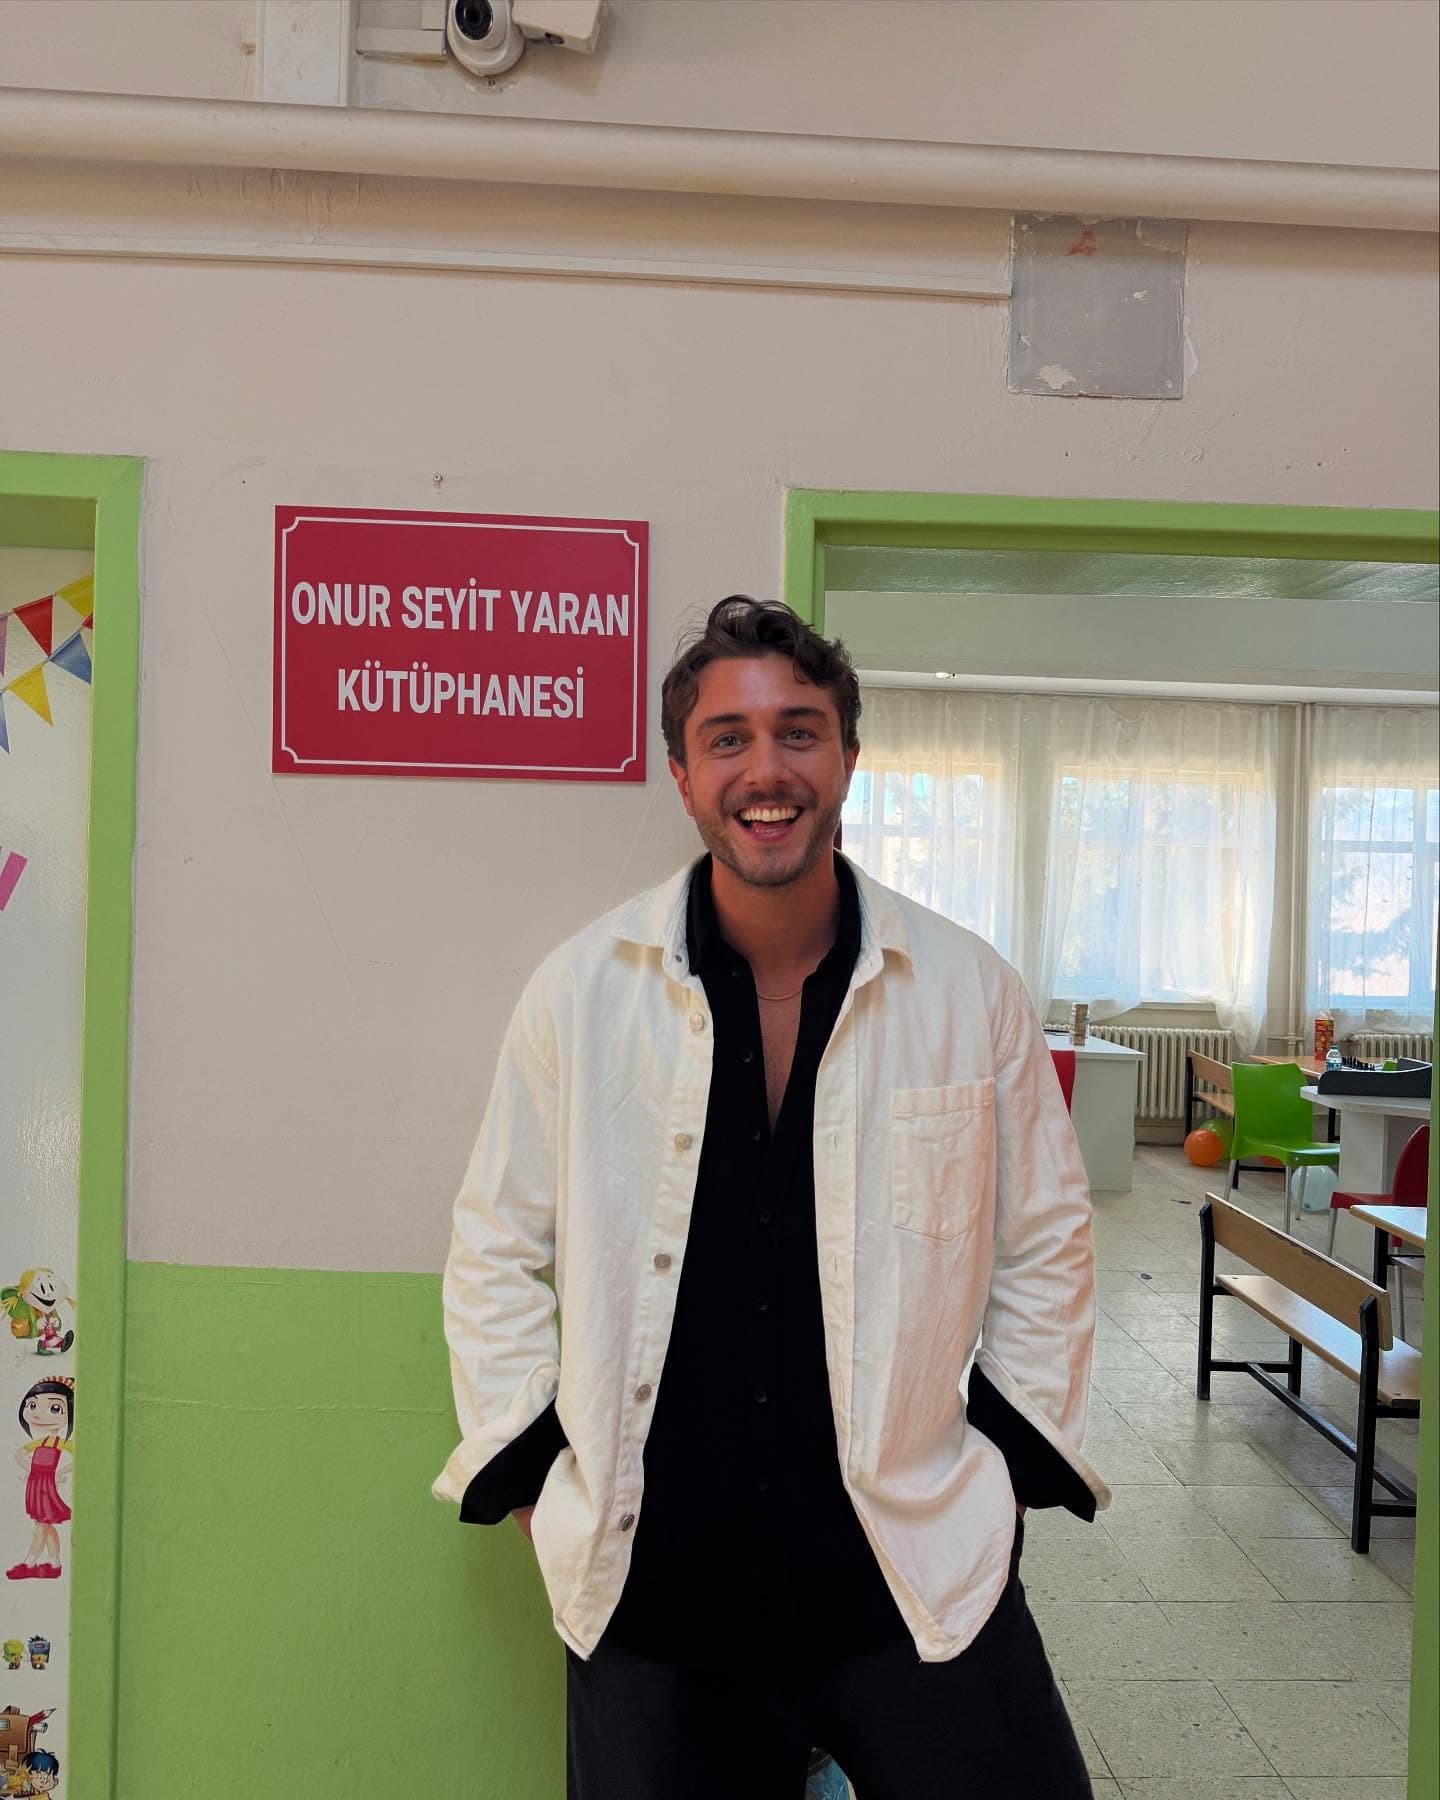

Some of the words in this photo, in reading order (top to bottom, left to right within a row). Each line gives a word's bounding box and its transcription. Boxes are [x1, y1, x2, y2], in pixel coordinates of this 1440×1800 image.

[291, 581, 391, 628] ONUR
[401, 577, 502, 632] SEYİT
[509, 590, 630, 637] YARAN
[337, 659, 585, 719] KÜTÜPHANESİ
